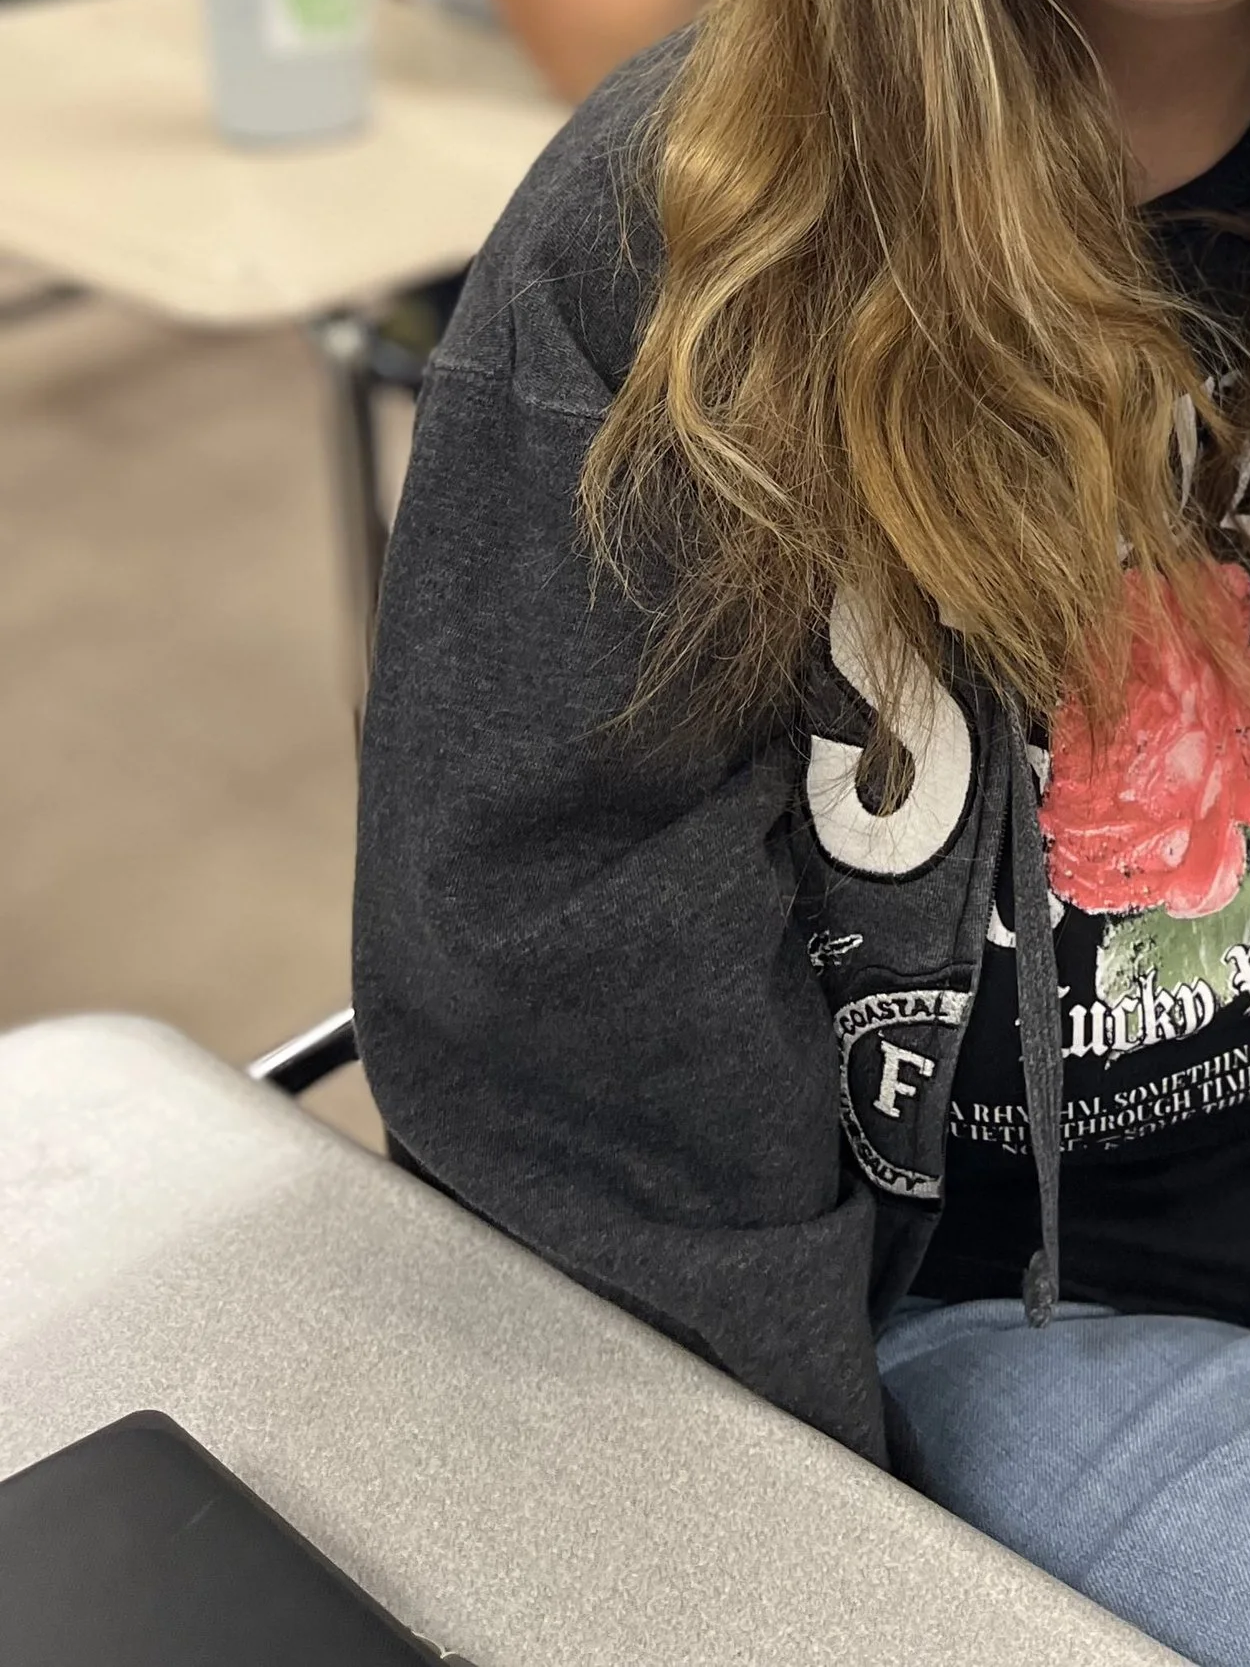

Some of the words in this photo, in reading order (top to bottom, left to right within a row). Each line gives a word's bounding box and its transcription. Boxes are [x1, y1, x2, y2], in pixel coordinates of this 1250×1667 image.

[839, 995, 949, 1036] COASTAL
[1015, 967, 1215, 1070] ucky
[873, 1039, 935, 1118] F
[974, 1097, 1107, 1124] RHYHM.
[1059, 1088, 1191, 1136] THROUGH
